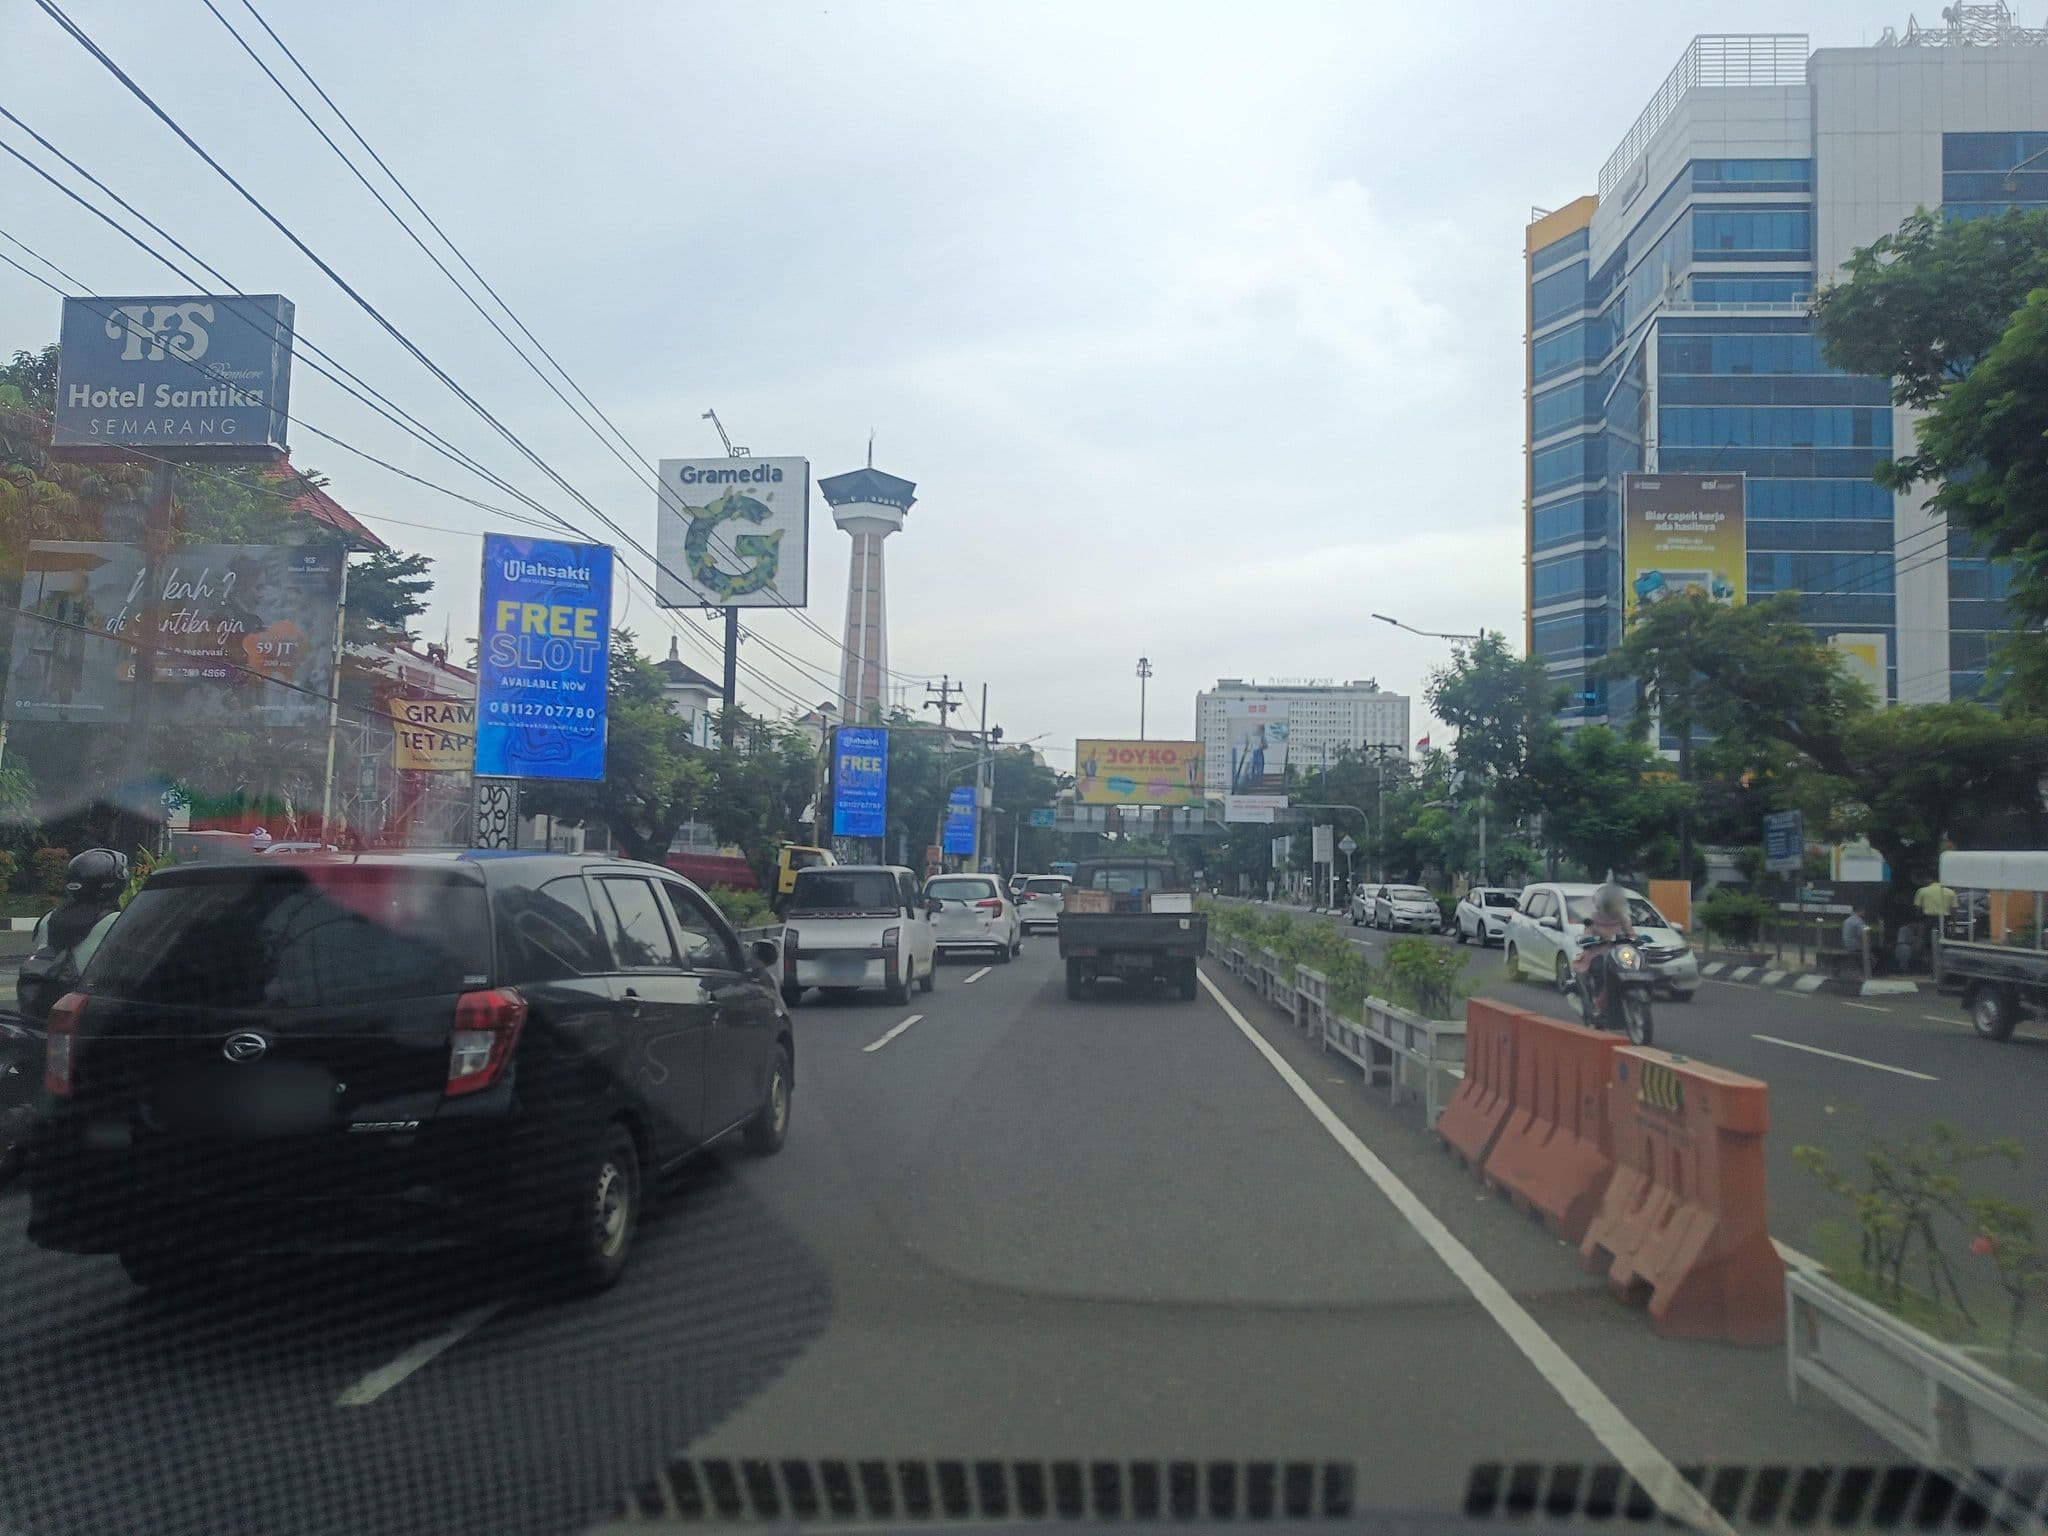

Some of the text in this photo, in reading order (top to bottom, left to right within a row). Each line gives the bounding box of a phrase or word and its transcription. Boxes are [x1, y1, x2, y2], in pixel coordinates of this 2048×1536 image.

[68, 383, 264, 408] Hotel Santika
[89, 418, 237, 435] SEMARANG
[680, 464, 783, 484] Gramedia
[504, 560, 590, 582] Ulahsakti
[496, 601, 598, 639] FREE
[256, 642, 273, 655] 59
[489, 634, 601, 673] SLOT
[501, 677, 586, 691] AVAILABLE NOW
[490, 702, 596, 719] 08112707780
[400, 731, 469, 752] TETAP
[841, 755, 882, 772] FREE
[1106, 747, 1177, 765] JOYKO
